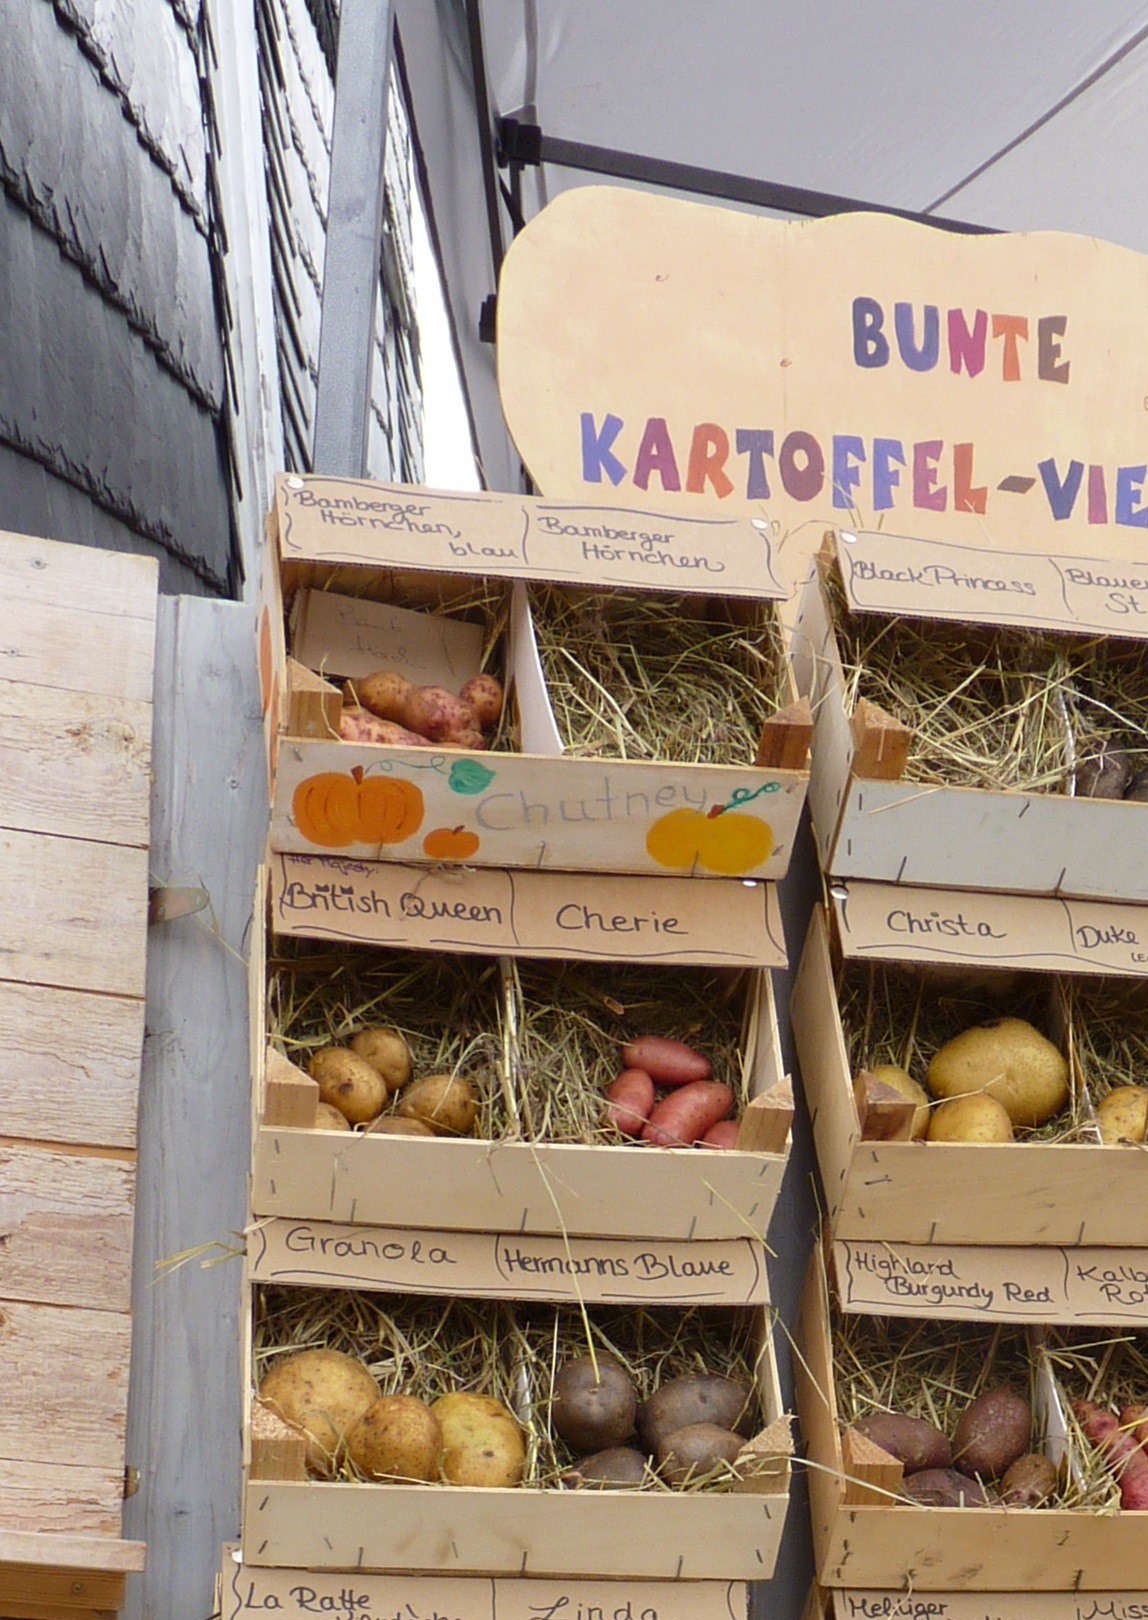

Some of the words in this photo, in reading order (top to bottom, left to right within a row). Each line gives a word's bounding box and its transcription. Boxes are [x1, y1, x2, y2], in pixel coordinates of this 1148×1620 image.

[853, 297, 1070, 384] BUNTE
[294, 490, 431, 517] Bamberger
[450, 540, 518, 558] blau
[538, 517, 676, 550] Bamberger
[583, 542, 725, 572] Hörnchen
[853, 560, 926, 584] Black
[922, 565, 1036, 596] Princess
[475, 777, 707, 833] Chutney
[286, 881, 391, 917] British
[400, 891, 502, 924] Queen
[556, 903, 689, 935] Cherie
[887, 911, 1006, 939] Christa
[1076, 924, 1140, 948] Duke
[285, 1227, 458, 1265] Granola
[503, 1247, 628, 1277] Hermanns
[636, 1255, 735, 1280] Blaue
[855, 1252, 958, 1280] Highland
[885, 1276, 995, 1308] Burgundy
[1004, 1283, 1055, 1304] Red
[244, 1587, 282, 1611] La
[289, 1588, 371, 1617] Ratte
